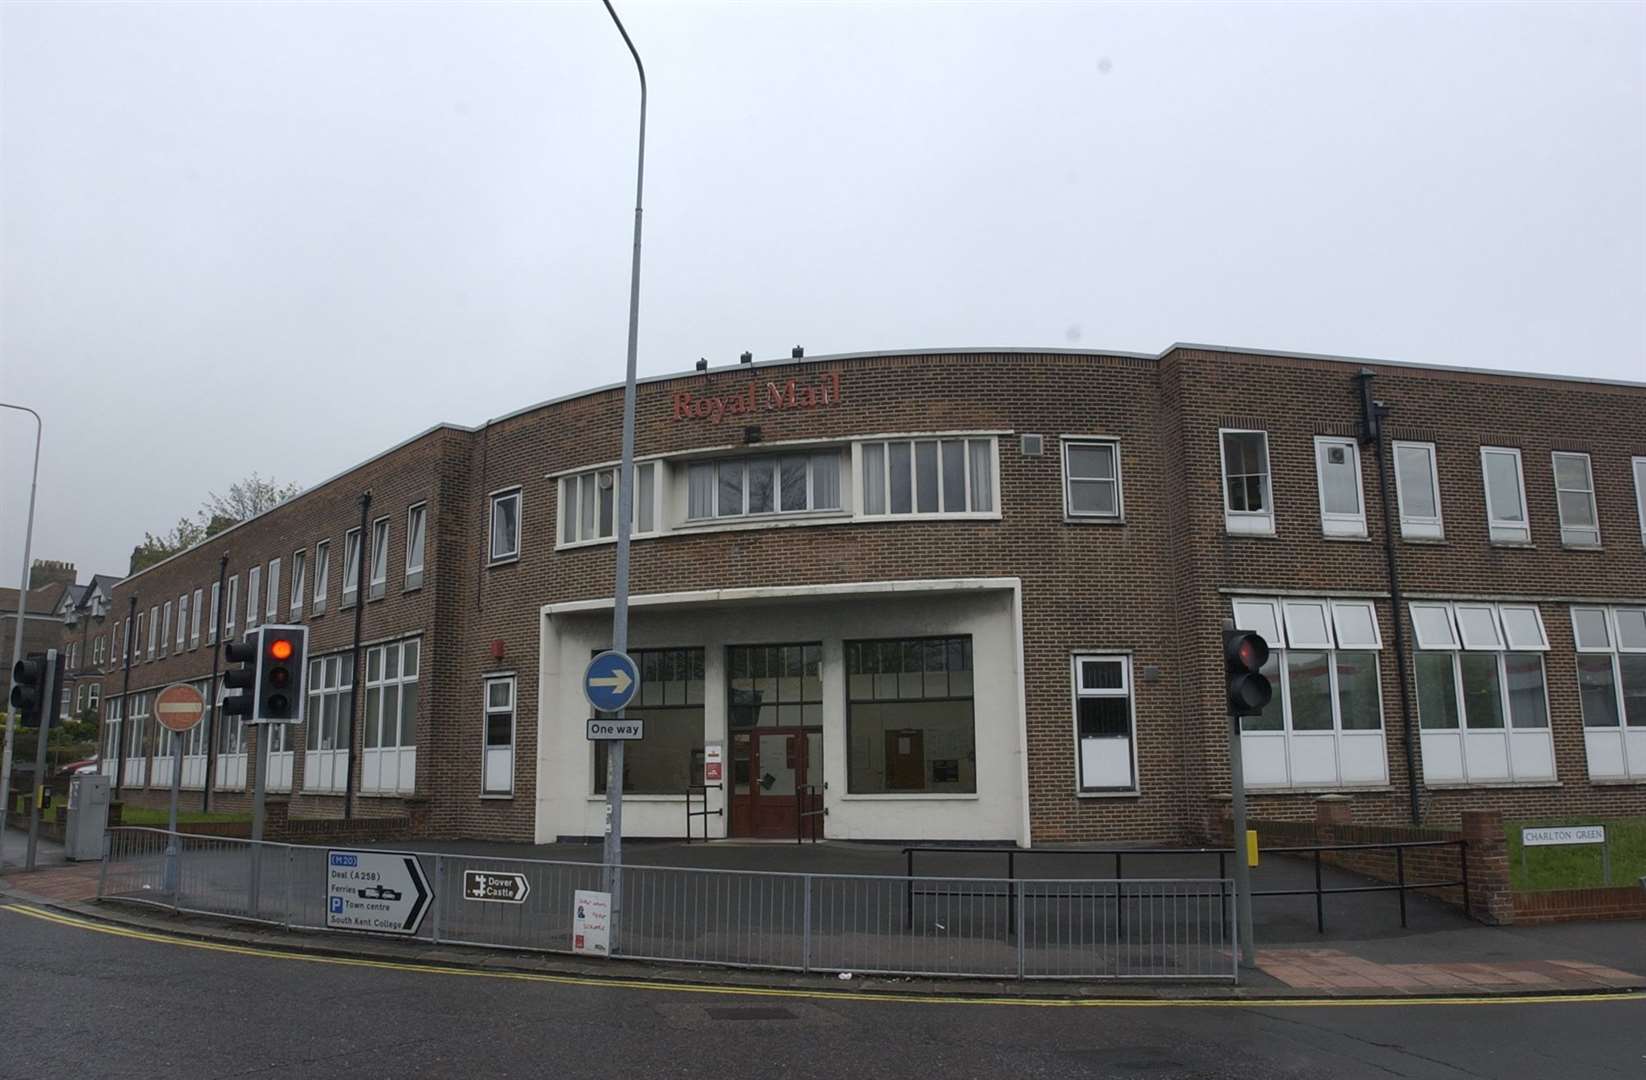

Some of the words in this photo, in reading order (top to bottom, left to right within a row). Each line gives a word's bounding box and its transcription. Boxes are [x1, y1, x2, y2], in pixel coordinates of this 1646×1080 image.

[672, 382, 757, 424] Royal
[765, 369, 841, 411] Mail
[591, 724, 614, 734] One
[616, 726, 639, 736] way
[1525, 831, 1572, 841] CHARLTON
[1575, 830, 1603, 840] GREEN
[331, 870, 348, 879] Deal
[488, 877, 513, 887] Dover
[331, 884, 356, 894] Ferries
[486, 887, 514, 897] Castle
[345, 900, 365, 909] Town
[366, 902, 390, 911] centre
[331, 915, 353, 925] South
[354, 917, 371, 926] Kent
[374, 919, 402, 929] College
